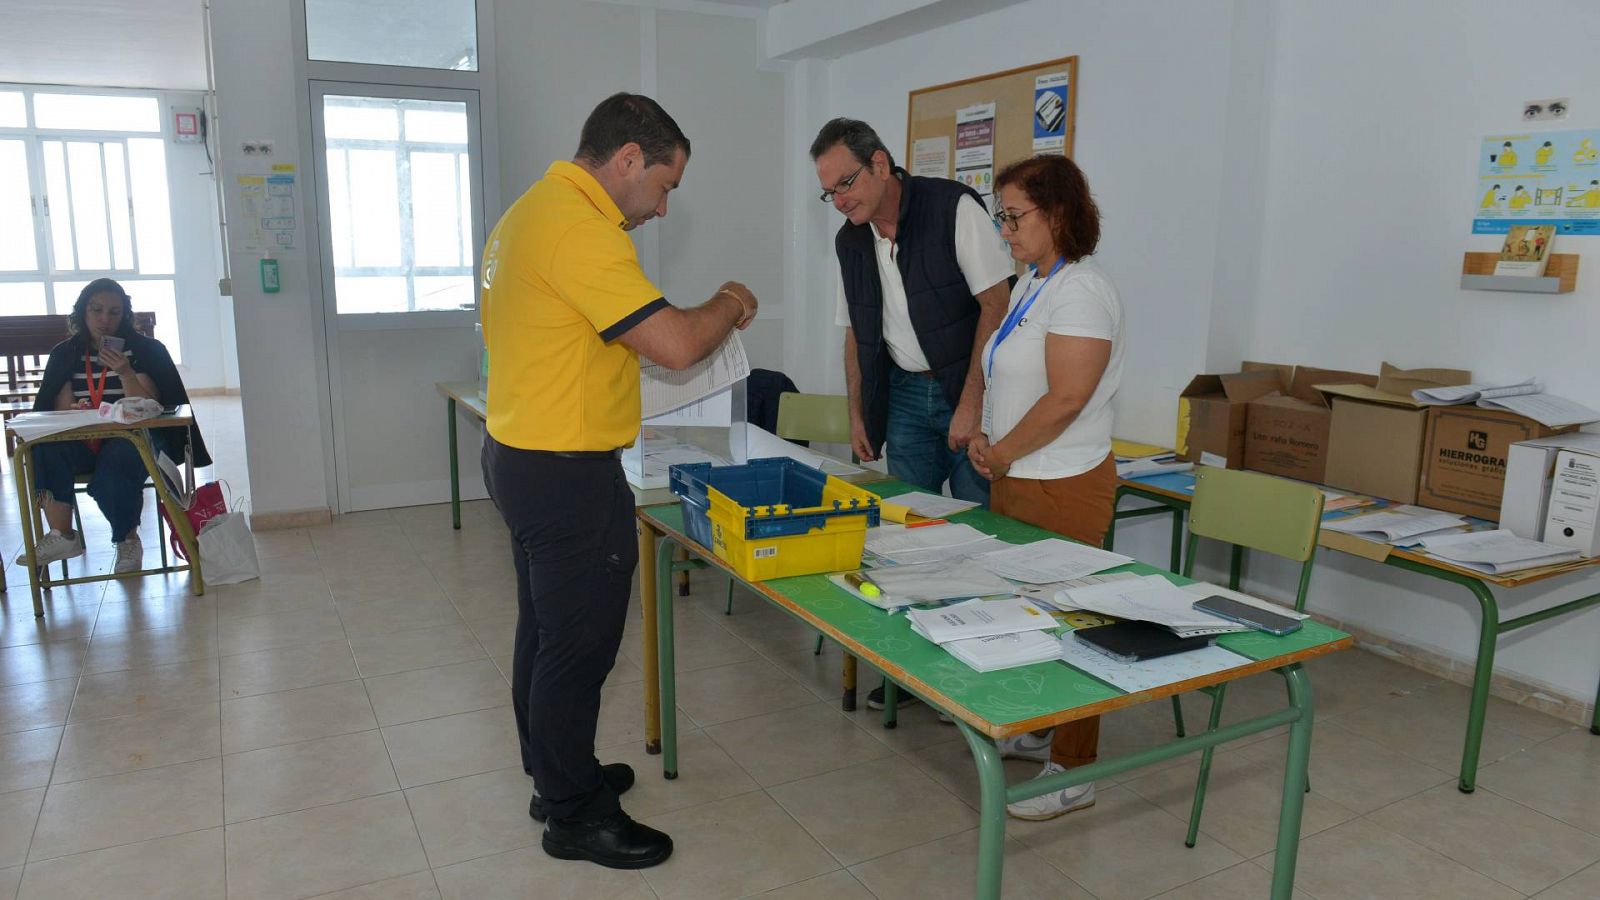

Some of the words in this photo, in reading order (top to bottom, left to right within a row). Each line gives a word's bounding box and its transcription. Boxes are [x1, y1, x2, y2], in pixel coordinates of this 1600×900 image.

[1289, 437, 1320, 450] Romero
[1469, 431, 1487, 450] HG
[1440, 448, 1506, 467] HIERROGRA
